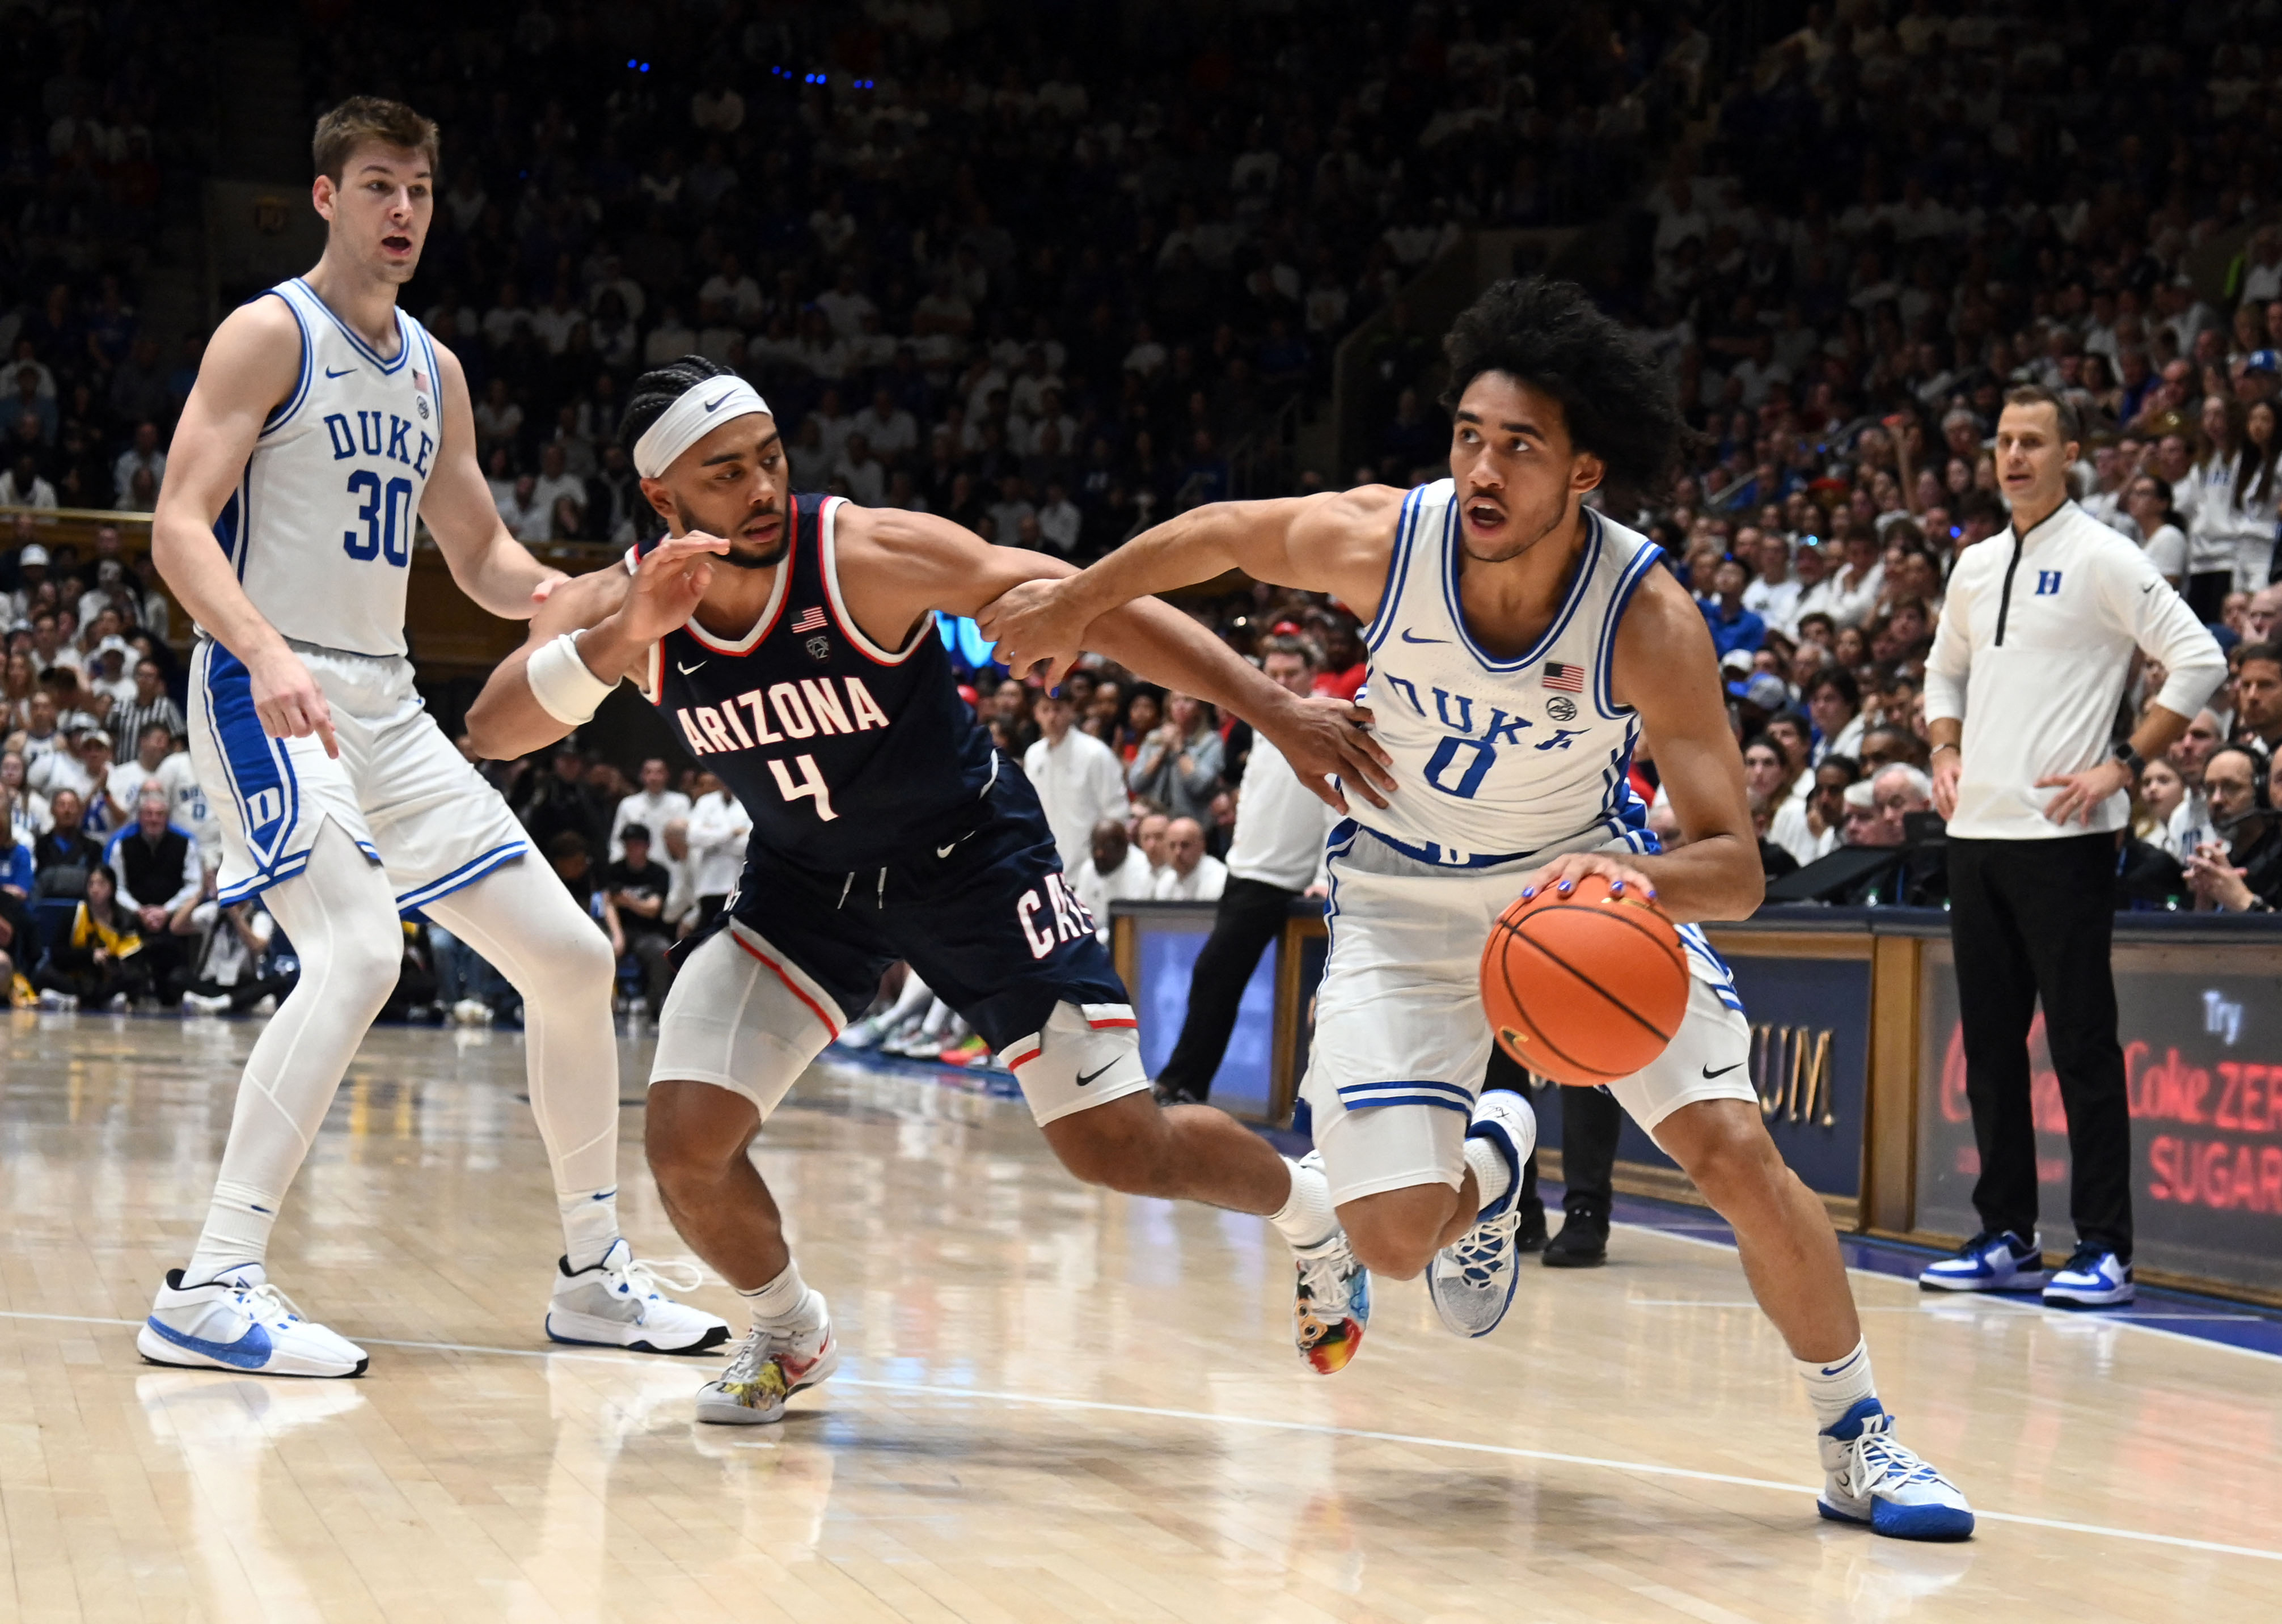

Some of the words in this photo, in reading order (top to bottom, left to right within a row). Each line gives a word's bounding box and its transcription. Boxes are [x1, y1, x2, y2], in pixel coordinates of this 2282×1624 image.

[323, 410, 434, 480] DUKE
[343, 469, 413, 568] 30
[677, 675, 890, 756] ARIZONA
[767, 754, 839, 822] 4
[1423, 735, 1497, 799] 0
[246, 786, 282, 831] D
[2149, 1134, 2282, 1215] SUGAR
